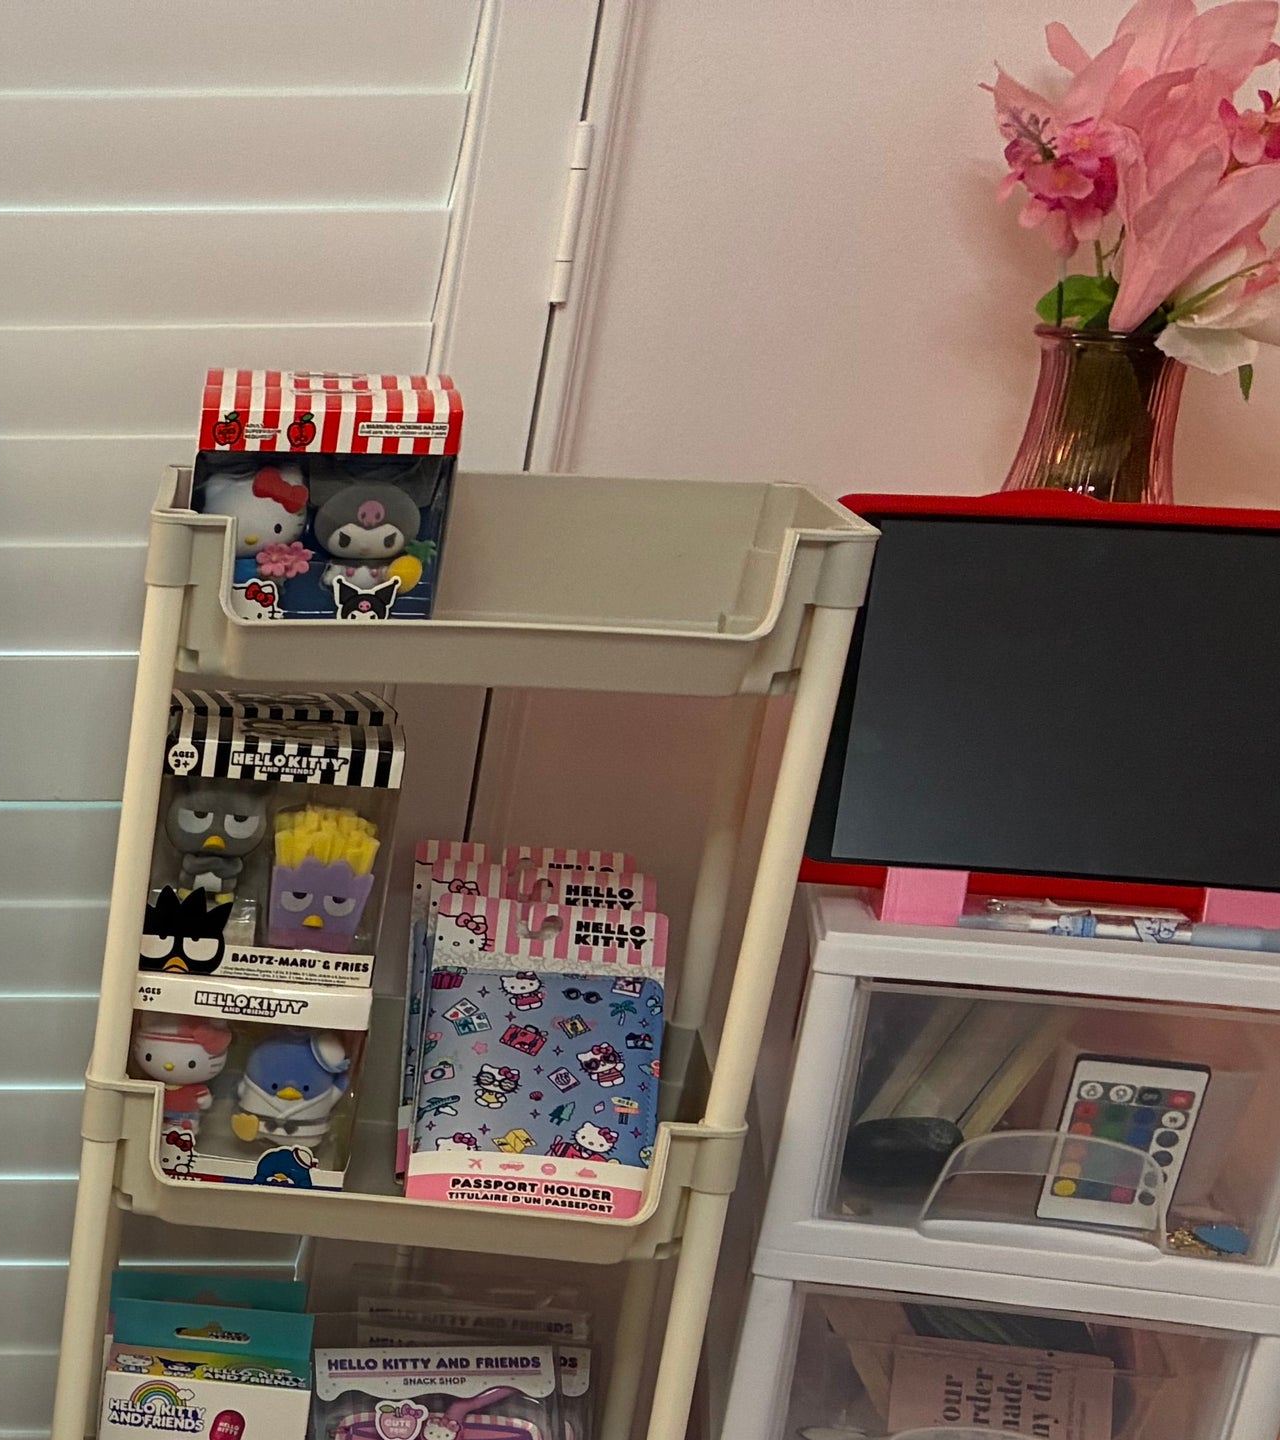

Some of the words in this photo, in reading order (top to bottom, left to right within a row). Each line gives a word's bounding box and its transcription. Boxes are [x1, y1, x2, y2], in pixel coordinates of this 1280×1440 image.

[172, 751, 195, 759] AGES
[233, 752, 287, 767] HELLO
[288, 755, 347, 771] KITTY
[174, 760, 190, 768] 3+
[576, 921, 646, 937] HELLO
[574, 934, 647, 950] KITTY
[335, 961, 370, 973] FRIES
[451, 1178, 539, 1193] PASSPORT
[544, 1184, 612, 1201] HOLDER
[448, 1192, 509, 1202] TITULAIRE
[512, 1195, 541, 1204] D'UN
[545, 1199, 613, 1213] PASSEPORT
[328, 1358, 378, 1370] HELLO
[382, 1358, 431, 1369] KITTY
[436, 1358, 470, 1369] AND
[476, 1356, 541, 1369] FRIENDS
[403, 1377, 437, 1385] SNACK
[439, 1377, 467, 1385] SHOP
